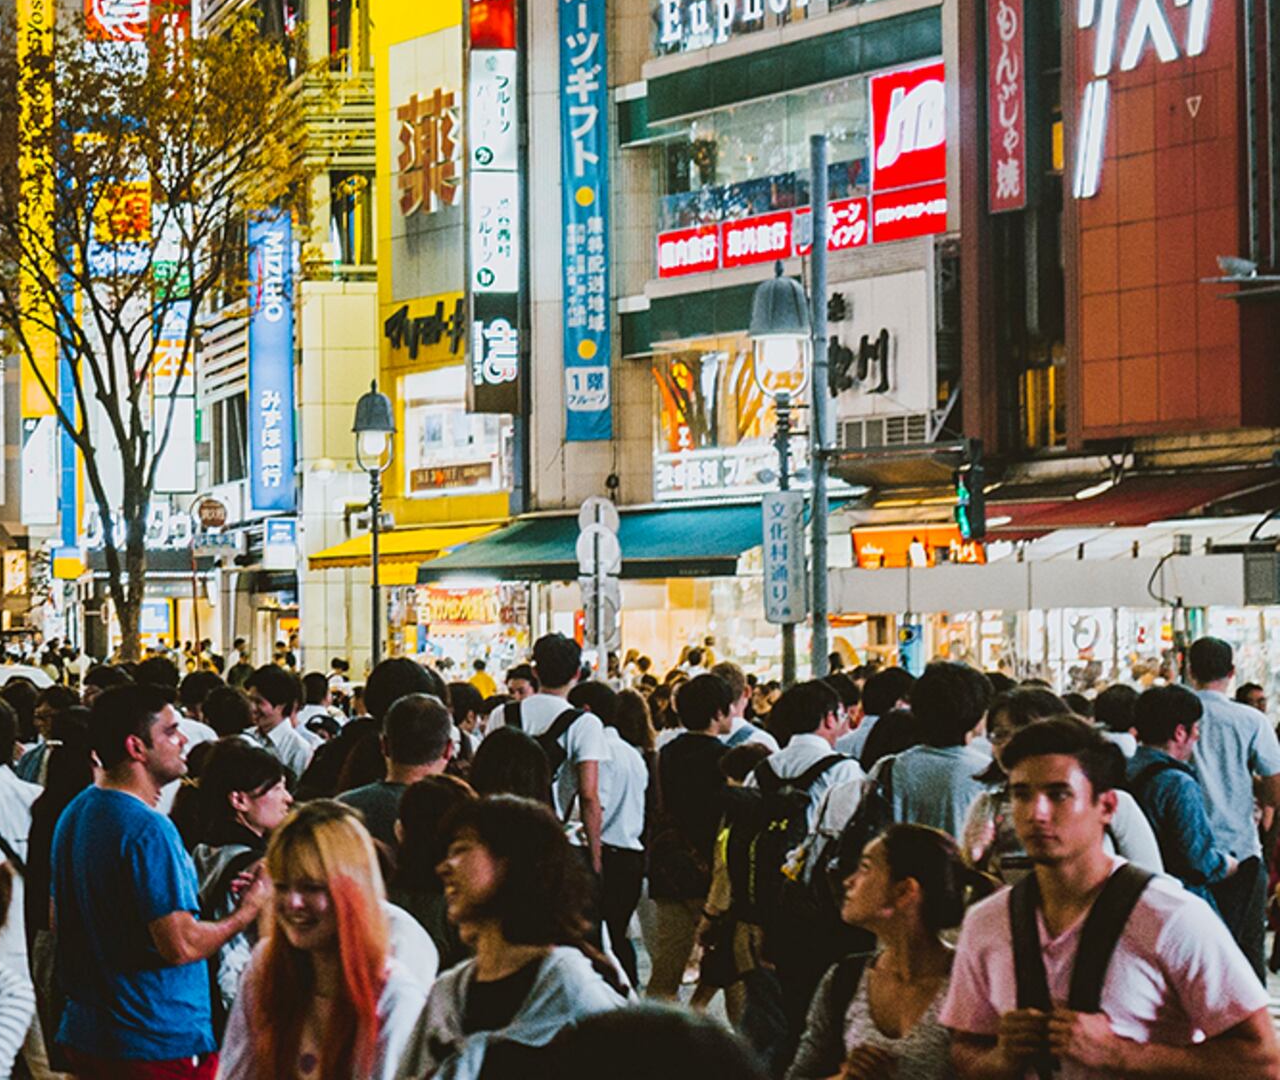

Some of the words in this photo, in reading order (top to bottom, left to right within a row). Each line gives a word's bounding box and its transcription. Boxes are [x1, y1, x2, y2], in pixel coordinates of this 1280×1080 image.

[397, 86, 460, 217] 薬
[995, 0, 1021, 198] もんじゃ焼
[263, 230, 285, 323] MIZUHO
[770, 502, 788, 604] 文化村通り
